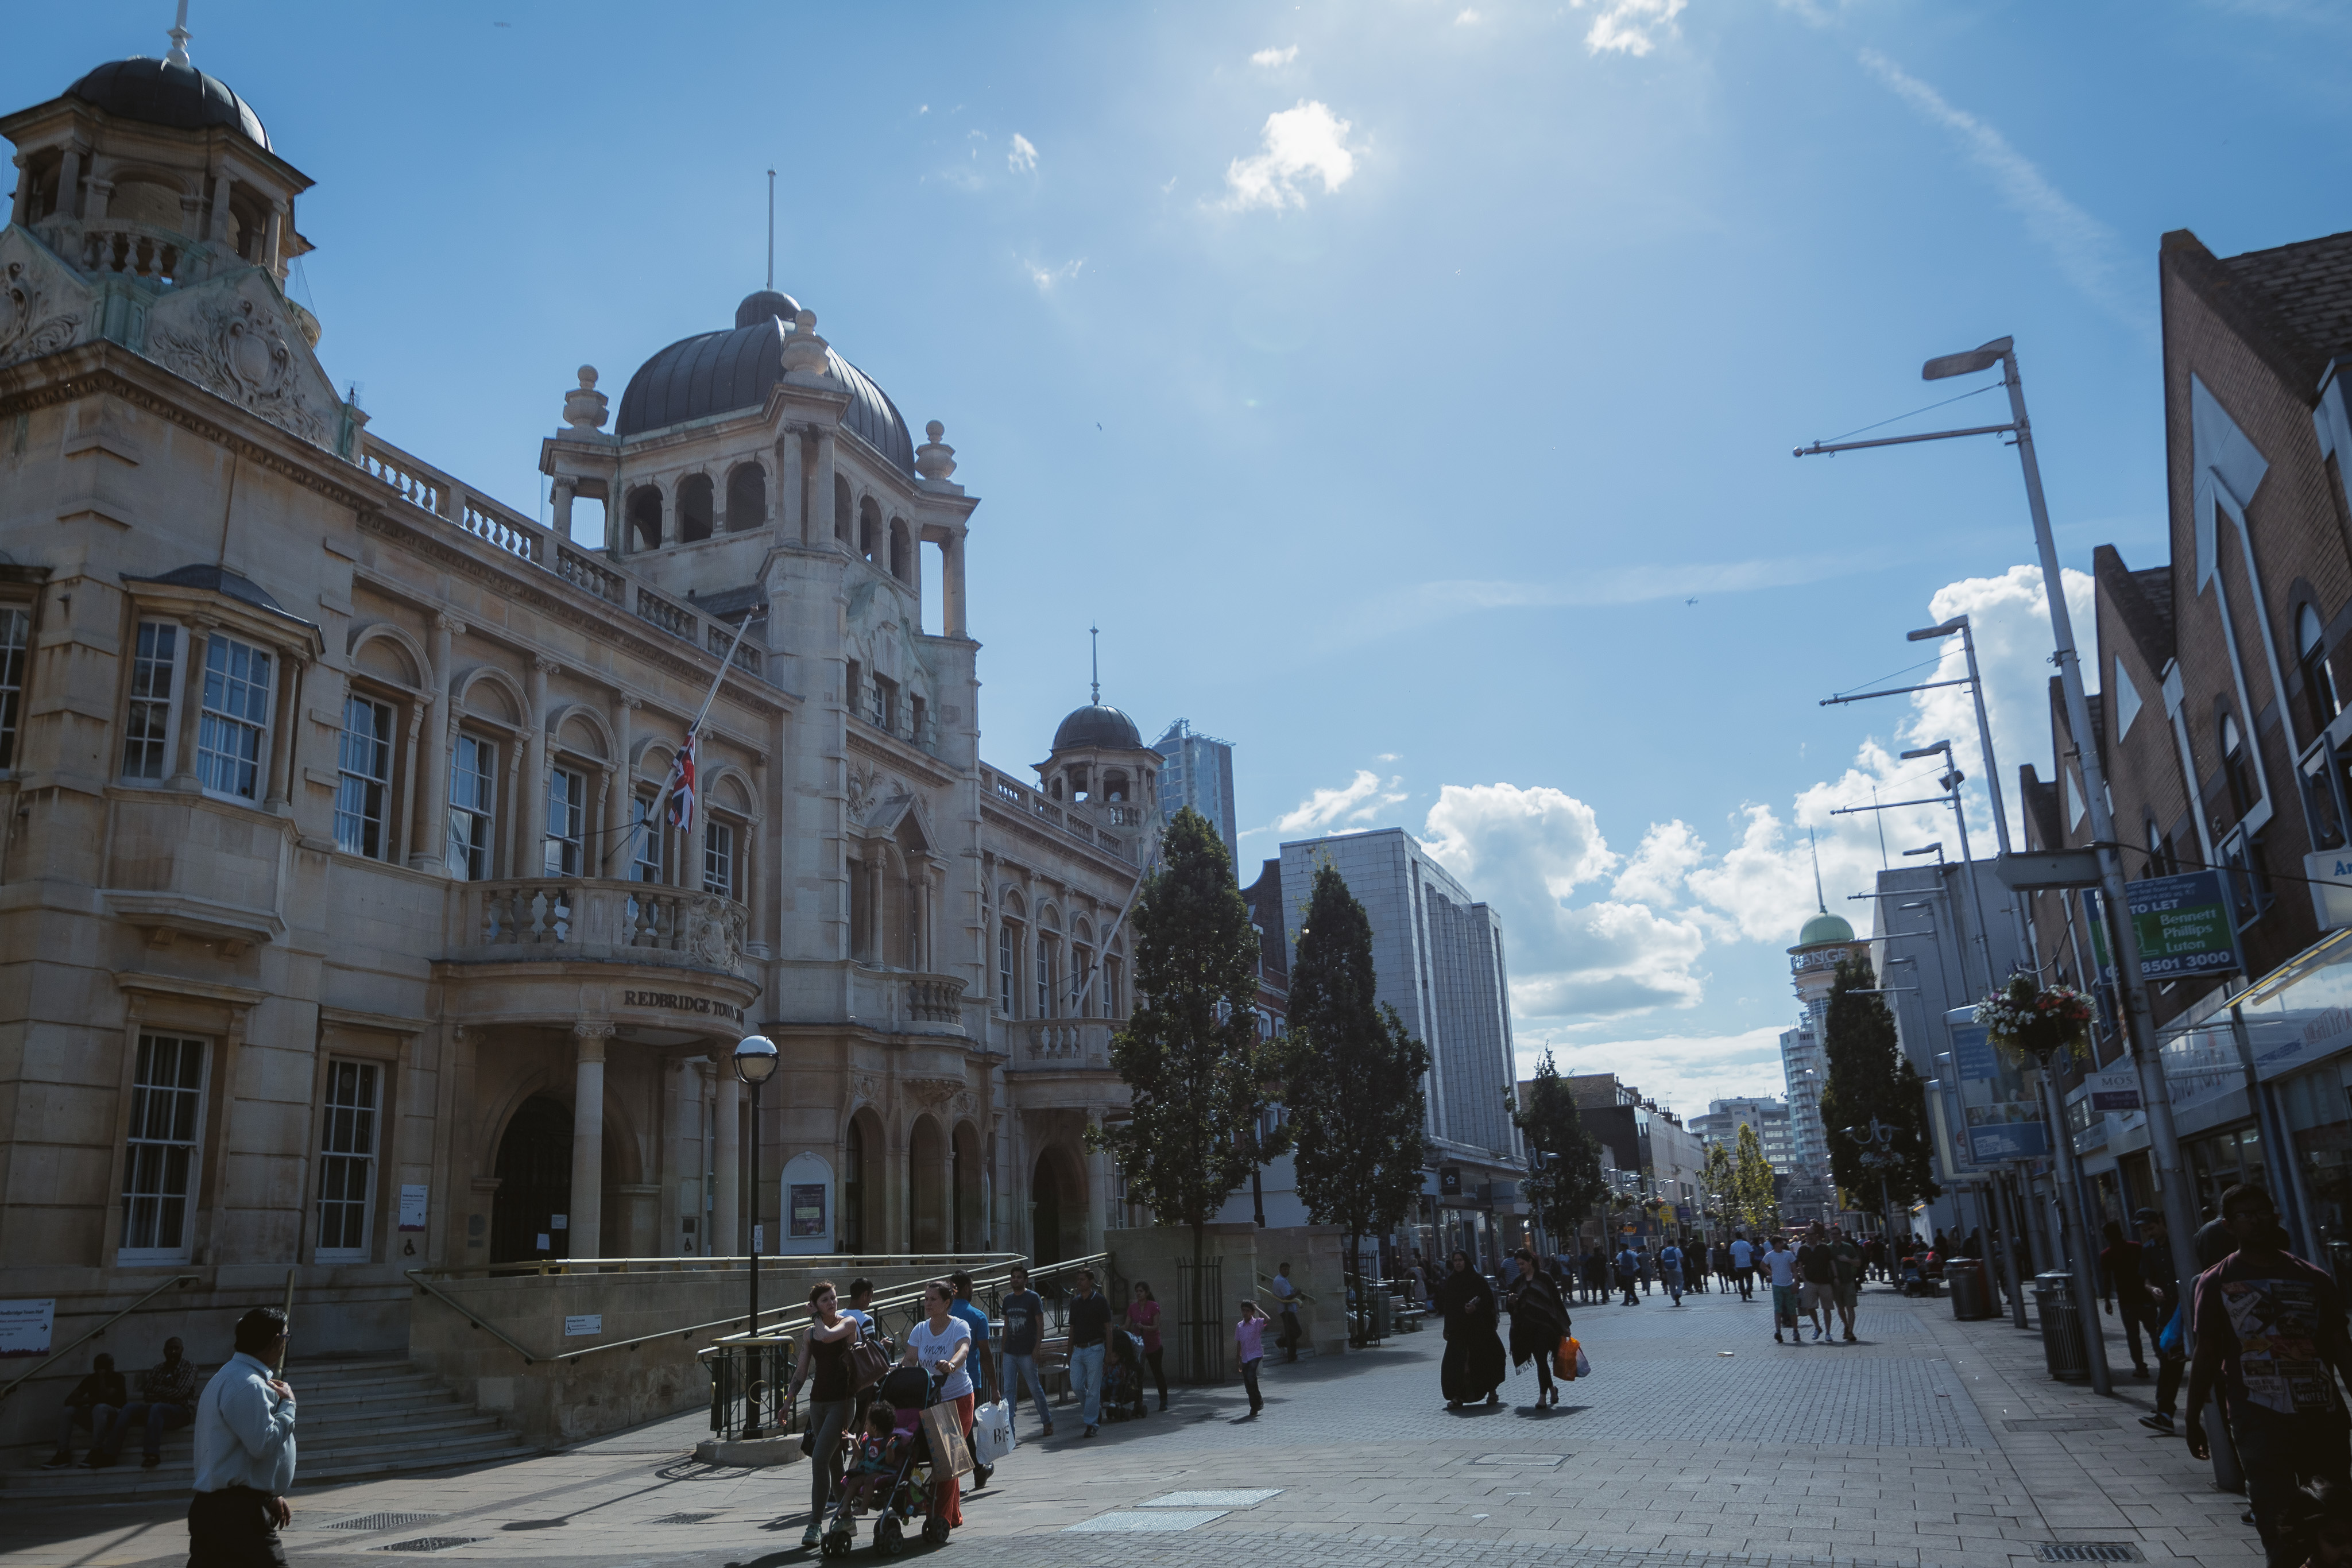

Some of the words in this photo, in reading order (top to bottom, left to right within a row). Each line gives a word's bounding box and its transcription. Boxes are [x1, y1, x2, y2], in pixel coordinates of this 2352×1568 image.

[2129, 904, 2149, 915] TO
[2152, 899, 2180, 912] LET
[2160, 909, 2216, 926] Bennett
[2163, 923, 2213, 939] Phillips
[2165, 939, 2206, 953] Luton
[2141, 957, 2181, 973] 8501
[2185, 951, 2230, 967] 3000
[624, 990, 710, 1013] REDBRIDGE
[924, 1345, 947, 1355] mon
[2297, 1392, 2328, 1403] MOTEL
